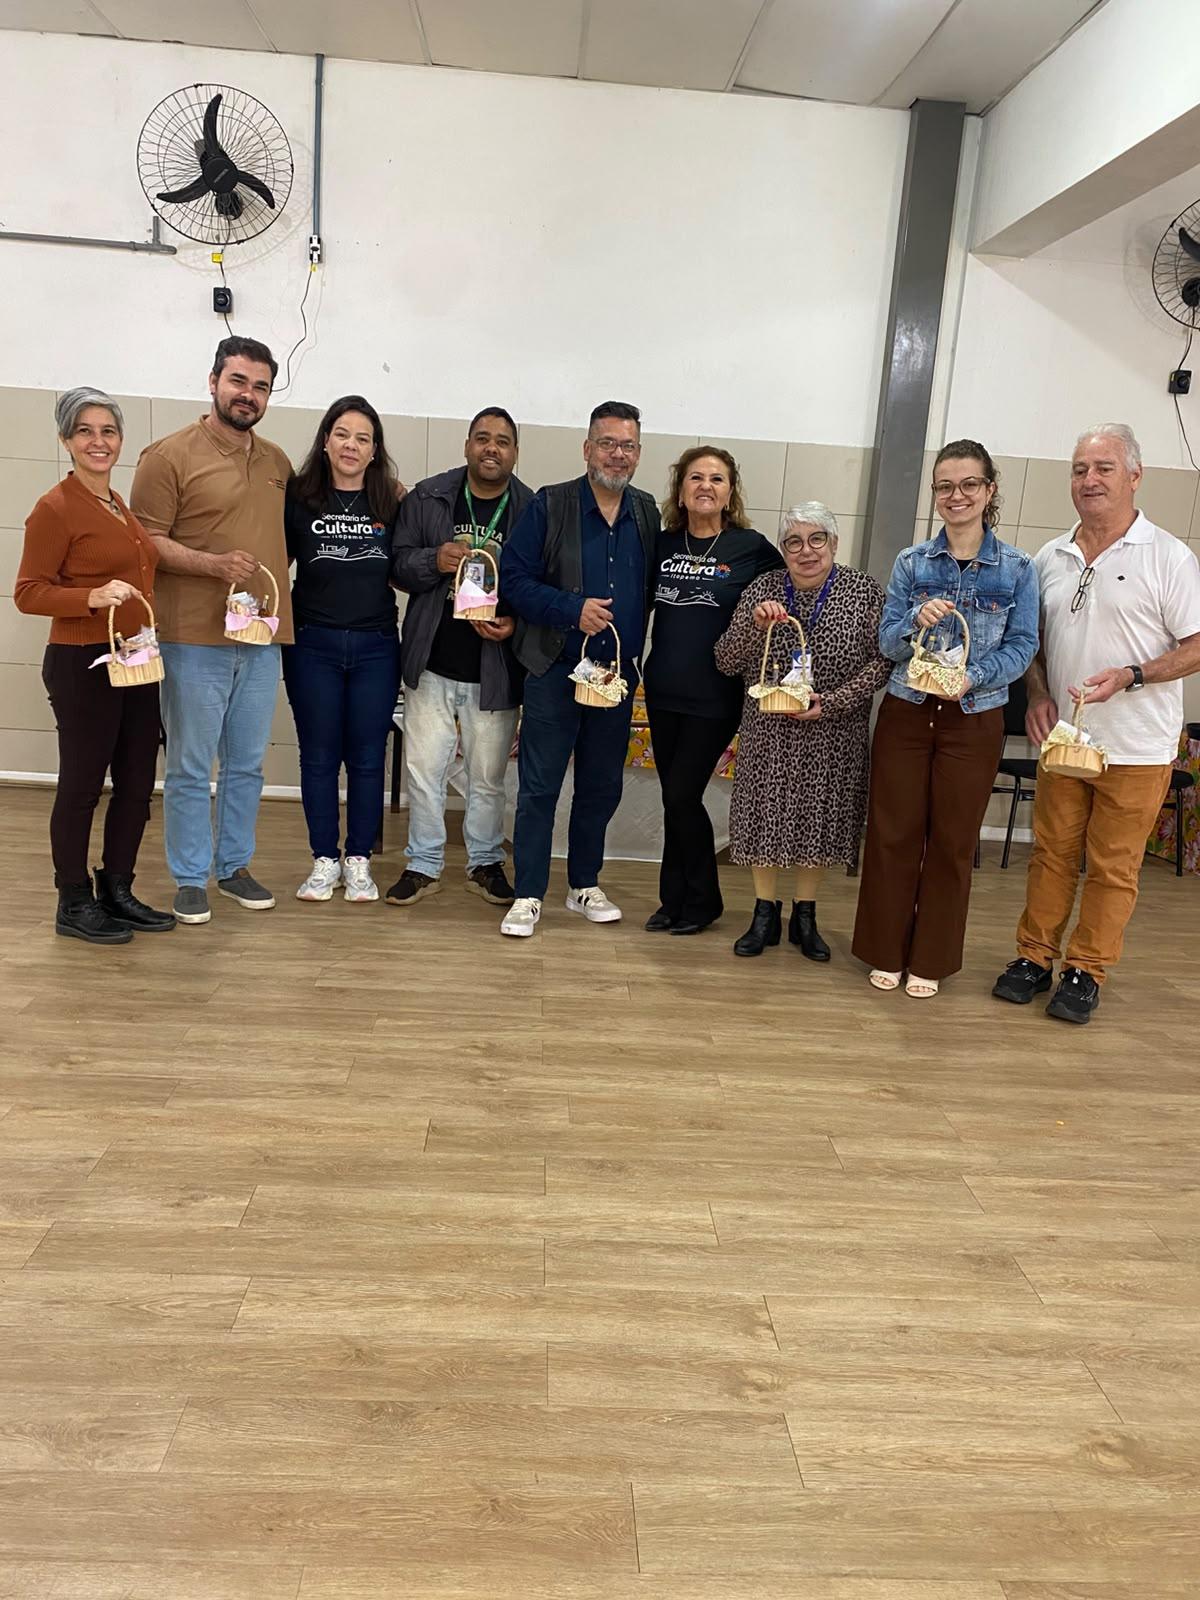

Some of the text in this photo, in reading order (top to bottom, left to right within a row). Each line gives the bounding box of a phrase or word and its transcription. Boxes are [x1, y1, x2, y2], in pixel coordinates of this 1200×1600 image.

[321, 512, 370, 522] Secretaria de
[311, 519, 373, 534] Cultura
[672, 552, 706, 563] Secretaria
[661, 558, 715, 576] Cultura
